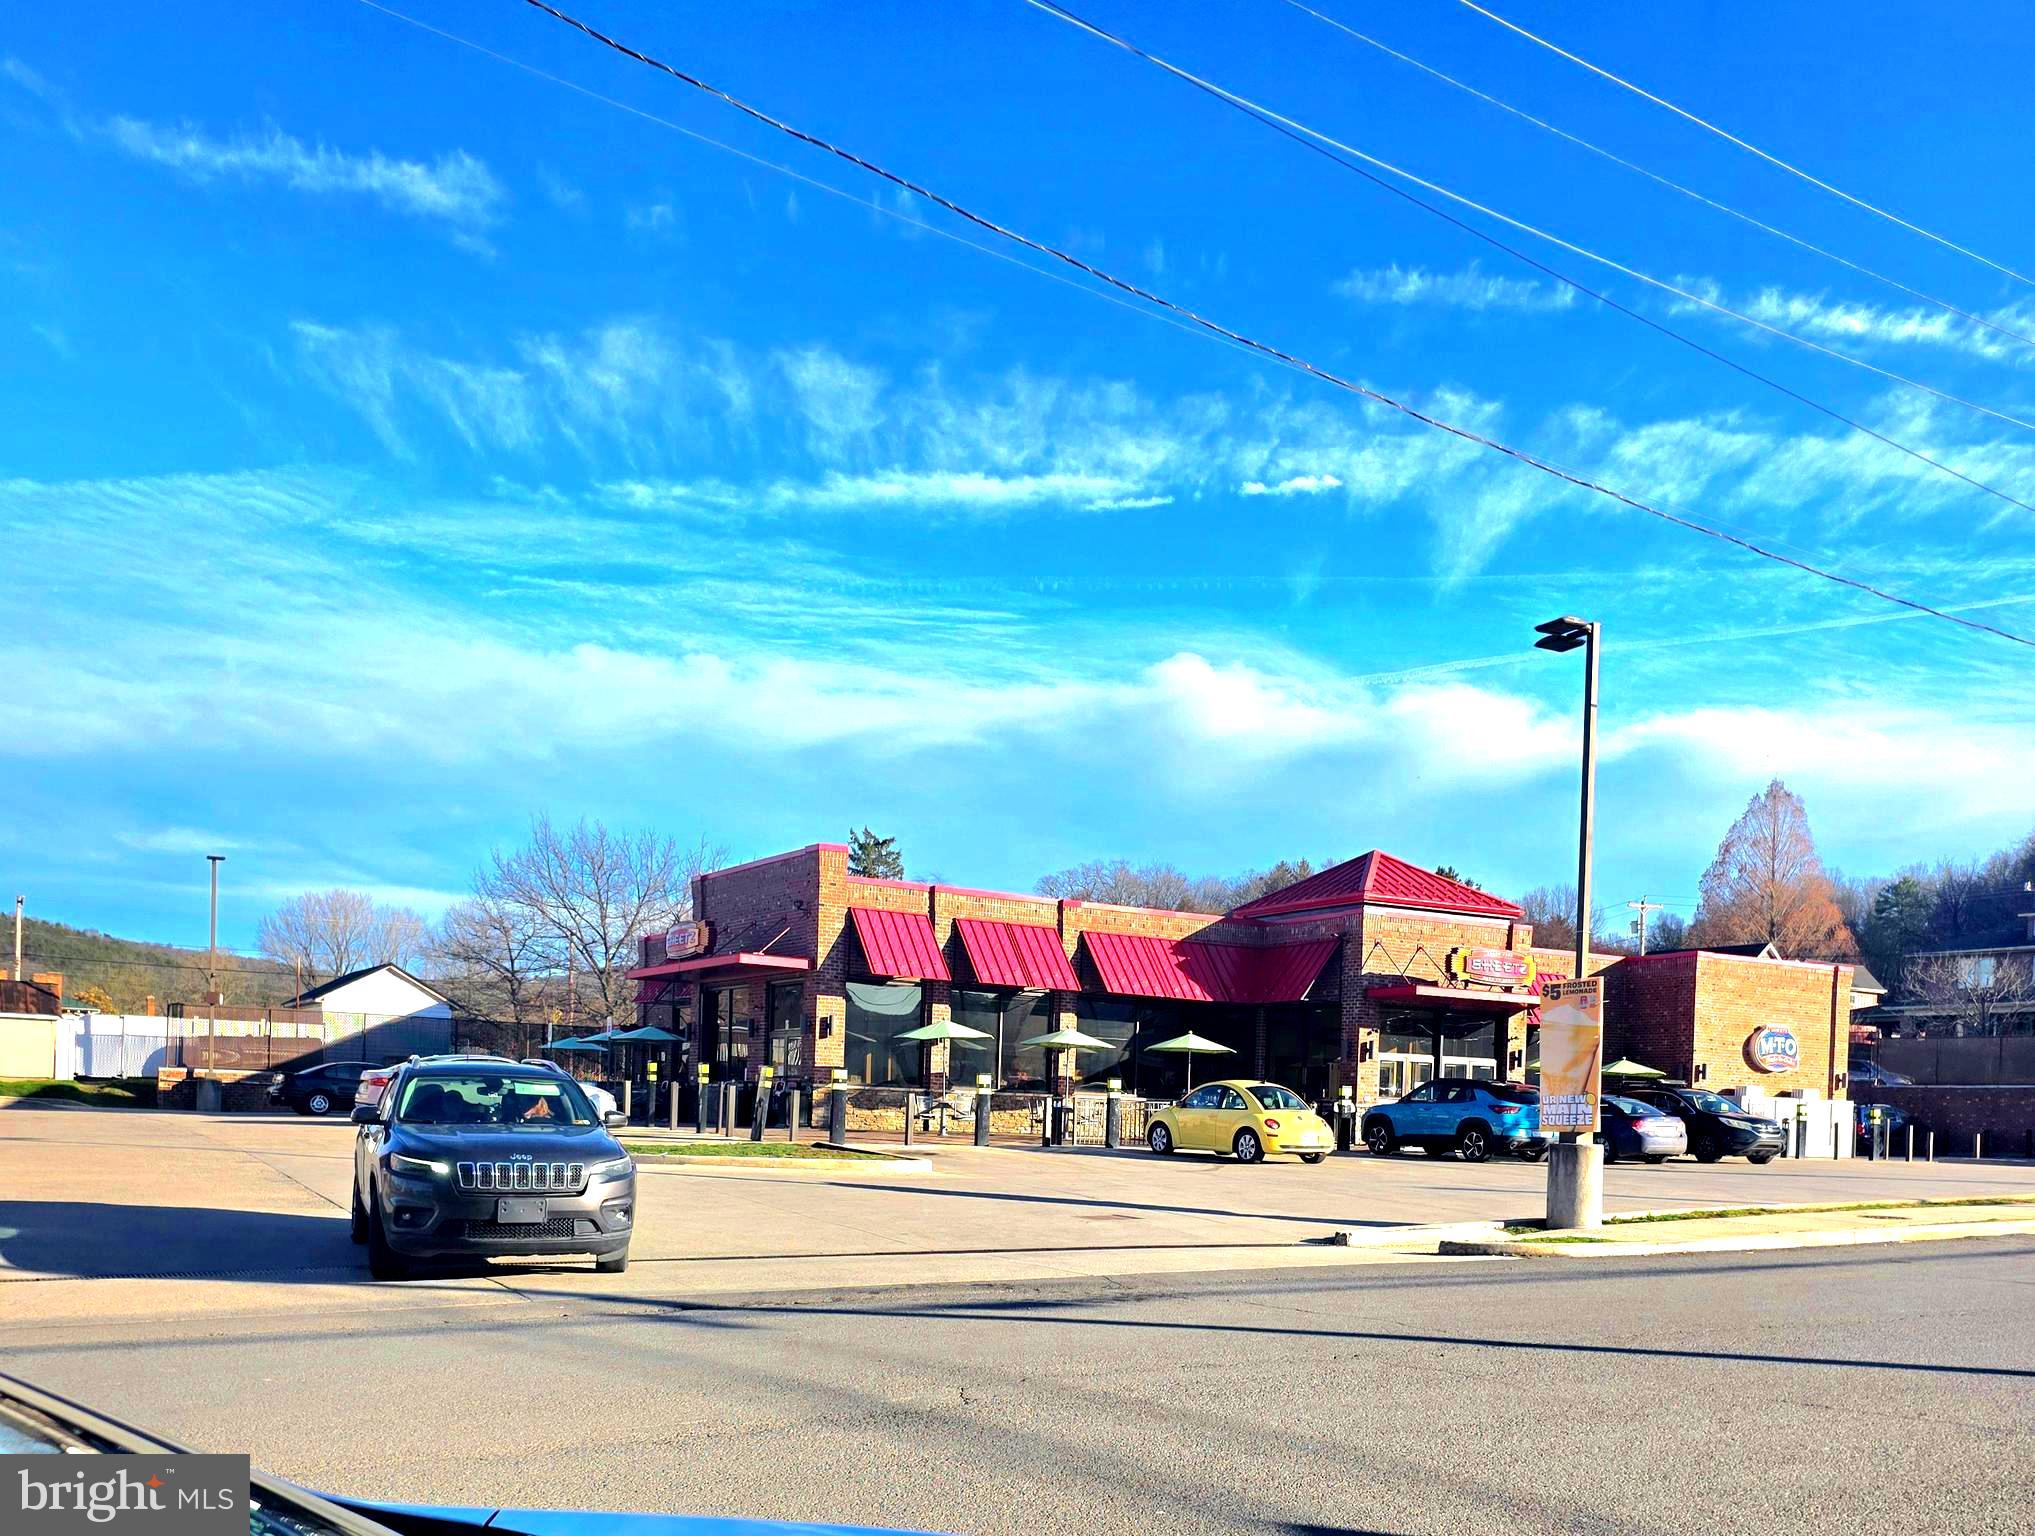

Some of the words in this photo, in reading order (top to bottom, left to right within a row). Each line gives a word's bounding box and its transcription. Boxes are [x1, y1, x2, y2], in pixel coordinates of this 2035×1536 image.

[1471, 959, 1528, 975] SHEETZ
[1563, 980, 1597, 989] FROSTED
[1542, 983, 1561, 1000] $5
[1563, 987, 1597, 996] LEMONADE
[1542, 1095, 1556, 1104] UR
[1559, 1094, 1586, 1104] NEW
[1543, 1104, 1593, 1115] MAIN
[1541, 1114, 1593, 1125] SQUEEZE
[510, 1153, 532, 1161] Jeep
